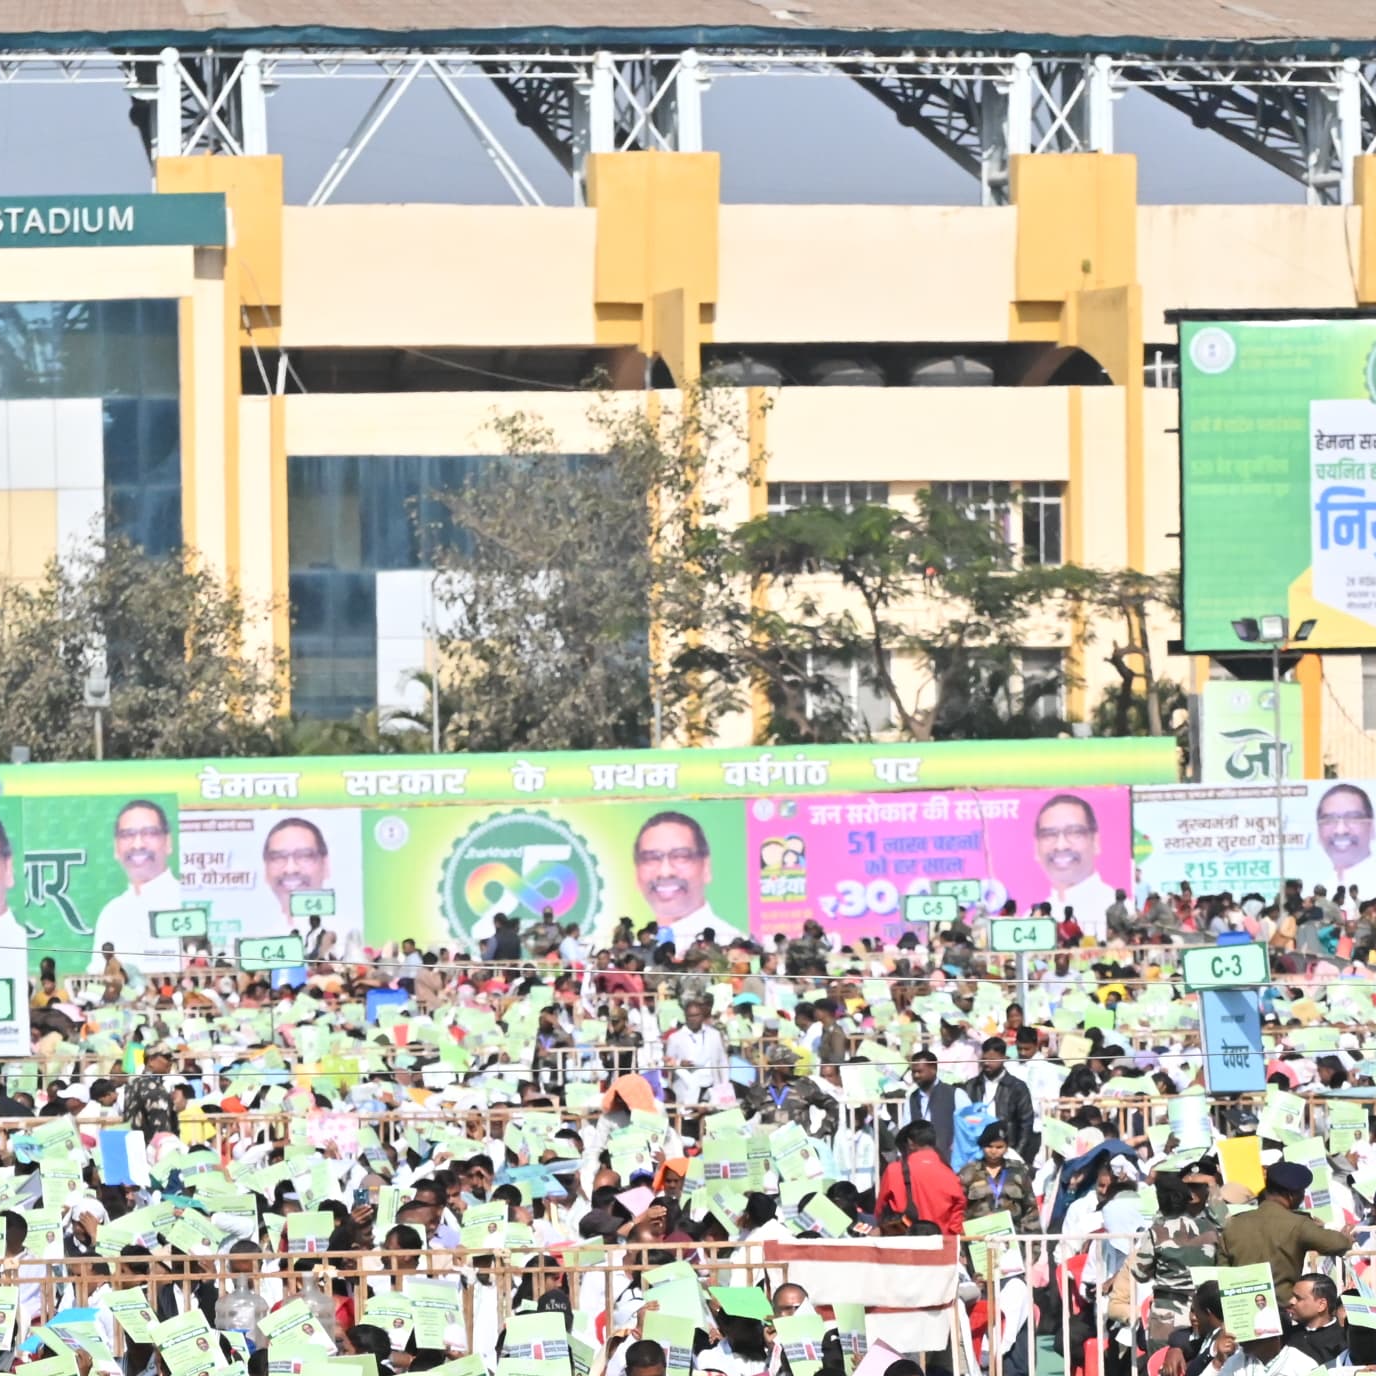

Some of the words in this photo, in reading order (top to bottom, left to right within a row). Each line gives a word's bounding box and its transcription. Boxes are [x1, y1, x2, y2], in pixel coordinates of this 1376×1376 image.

[1314, 429, 1355, 451] हेमन्त
[1315, 457, 1365, 480] चयनित
[198, 767, 301, 799] हेमन्त
[342, 768, 470, 796] सरकार
[511, 760, 546, 791] के
[590, 762, 679, 791] प्रथम
[722, 753, 830, 788] वर्षगांठ
[872, 756, 922, 784] पर
[809, 803, 841, 827] जन
[846, 797, 918, 825] सरोकार
[923, 796, 950, 820] की
[955, 798, 1020, 821] सरकार
[847, 830, 878, 854] 51
[1184, 861, 1218, 879] ₹15
[1224, 860, 1272, 876] लाख
[922, 901, 943, 916] C-5
[171, 917, 192, 932] C-5
[1012, 928, 1037, 945] C-4
[261, 945, 286, 962] C-4
[1211, 952, 1243, 978] C-3
